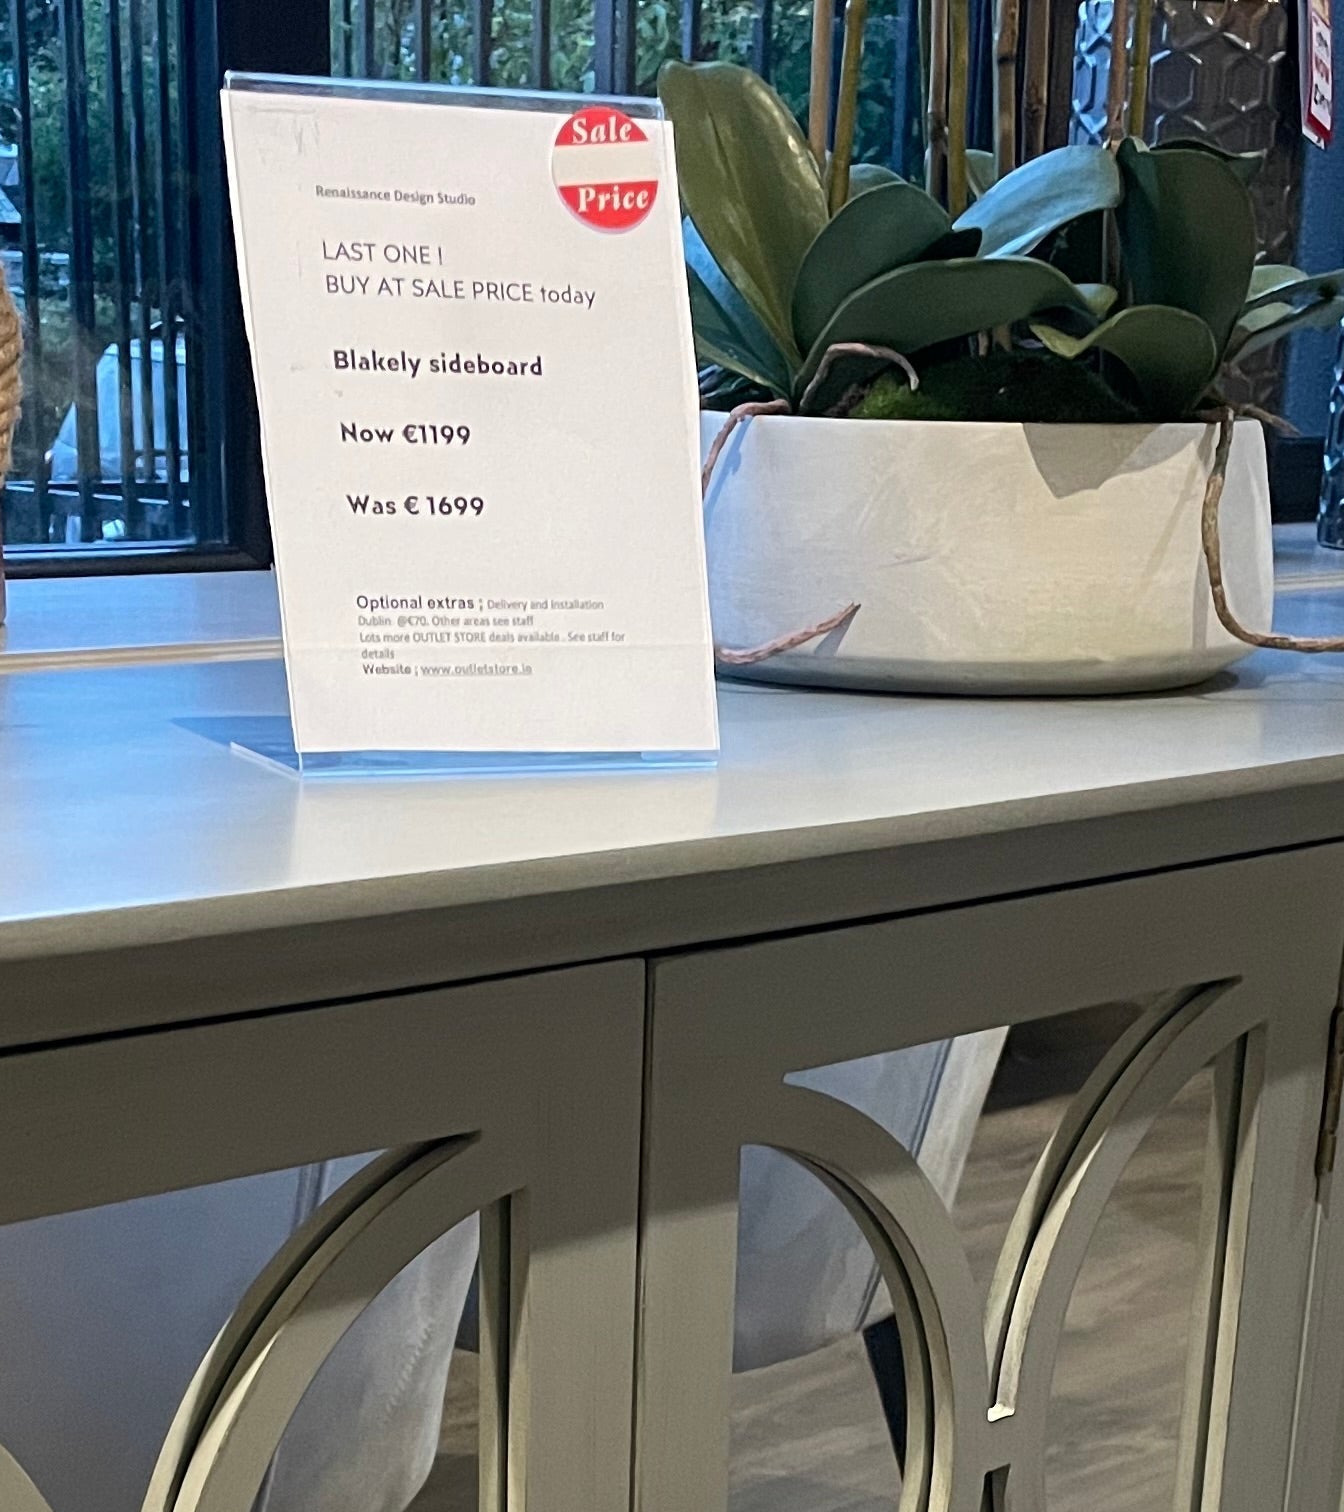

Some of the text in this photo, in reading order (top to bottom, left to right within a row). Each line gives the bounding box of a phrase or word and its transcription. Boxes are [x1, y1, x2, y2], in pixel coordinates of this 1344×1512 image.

[572, 115, 633, 144] Sale
[315, 185, 476, 206] Renaissance Design Studio
[578, 184, 649, 213] Price
[322, 239, 375, 262] LAST
[383, 243, 431, 265] ONE
[326, 274, 596, 310] BUY AT SALE PRICE today
[333, 349, 543, 379] Blakely sideboard
[340, 421, 471, 445] Now €1199
[346, 494, 397, 516] Was
[356, 595, 422, 612] Optional
[427, 597, 475, 610] extras
[487, 600, 528, 612] Delivery
[530, 600, 549, 610] and
[358, 615, 391, 627] Dublin
[431, 615, 461, 627] Other
[463, 617, 490, 627] areas
[492, 617, 510, 627] see
[512, 615, 534, 627] staff
[359, 632, 381, 643] Lots
[382, 633, 410, 643] more
[412, 632, 451, 643] OUTLET
[453, 632, 487, 643] STORE
[489, 632, 514, 643] deals
[567, 631, 586, 643] See
[587, 631, 609, 643] staff
[611, 631, 625, 643] for
[361, 649, 395, 660] details
[362, 664, 412, 676] Website
